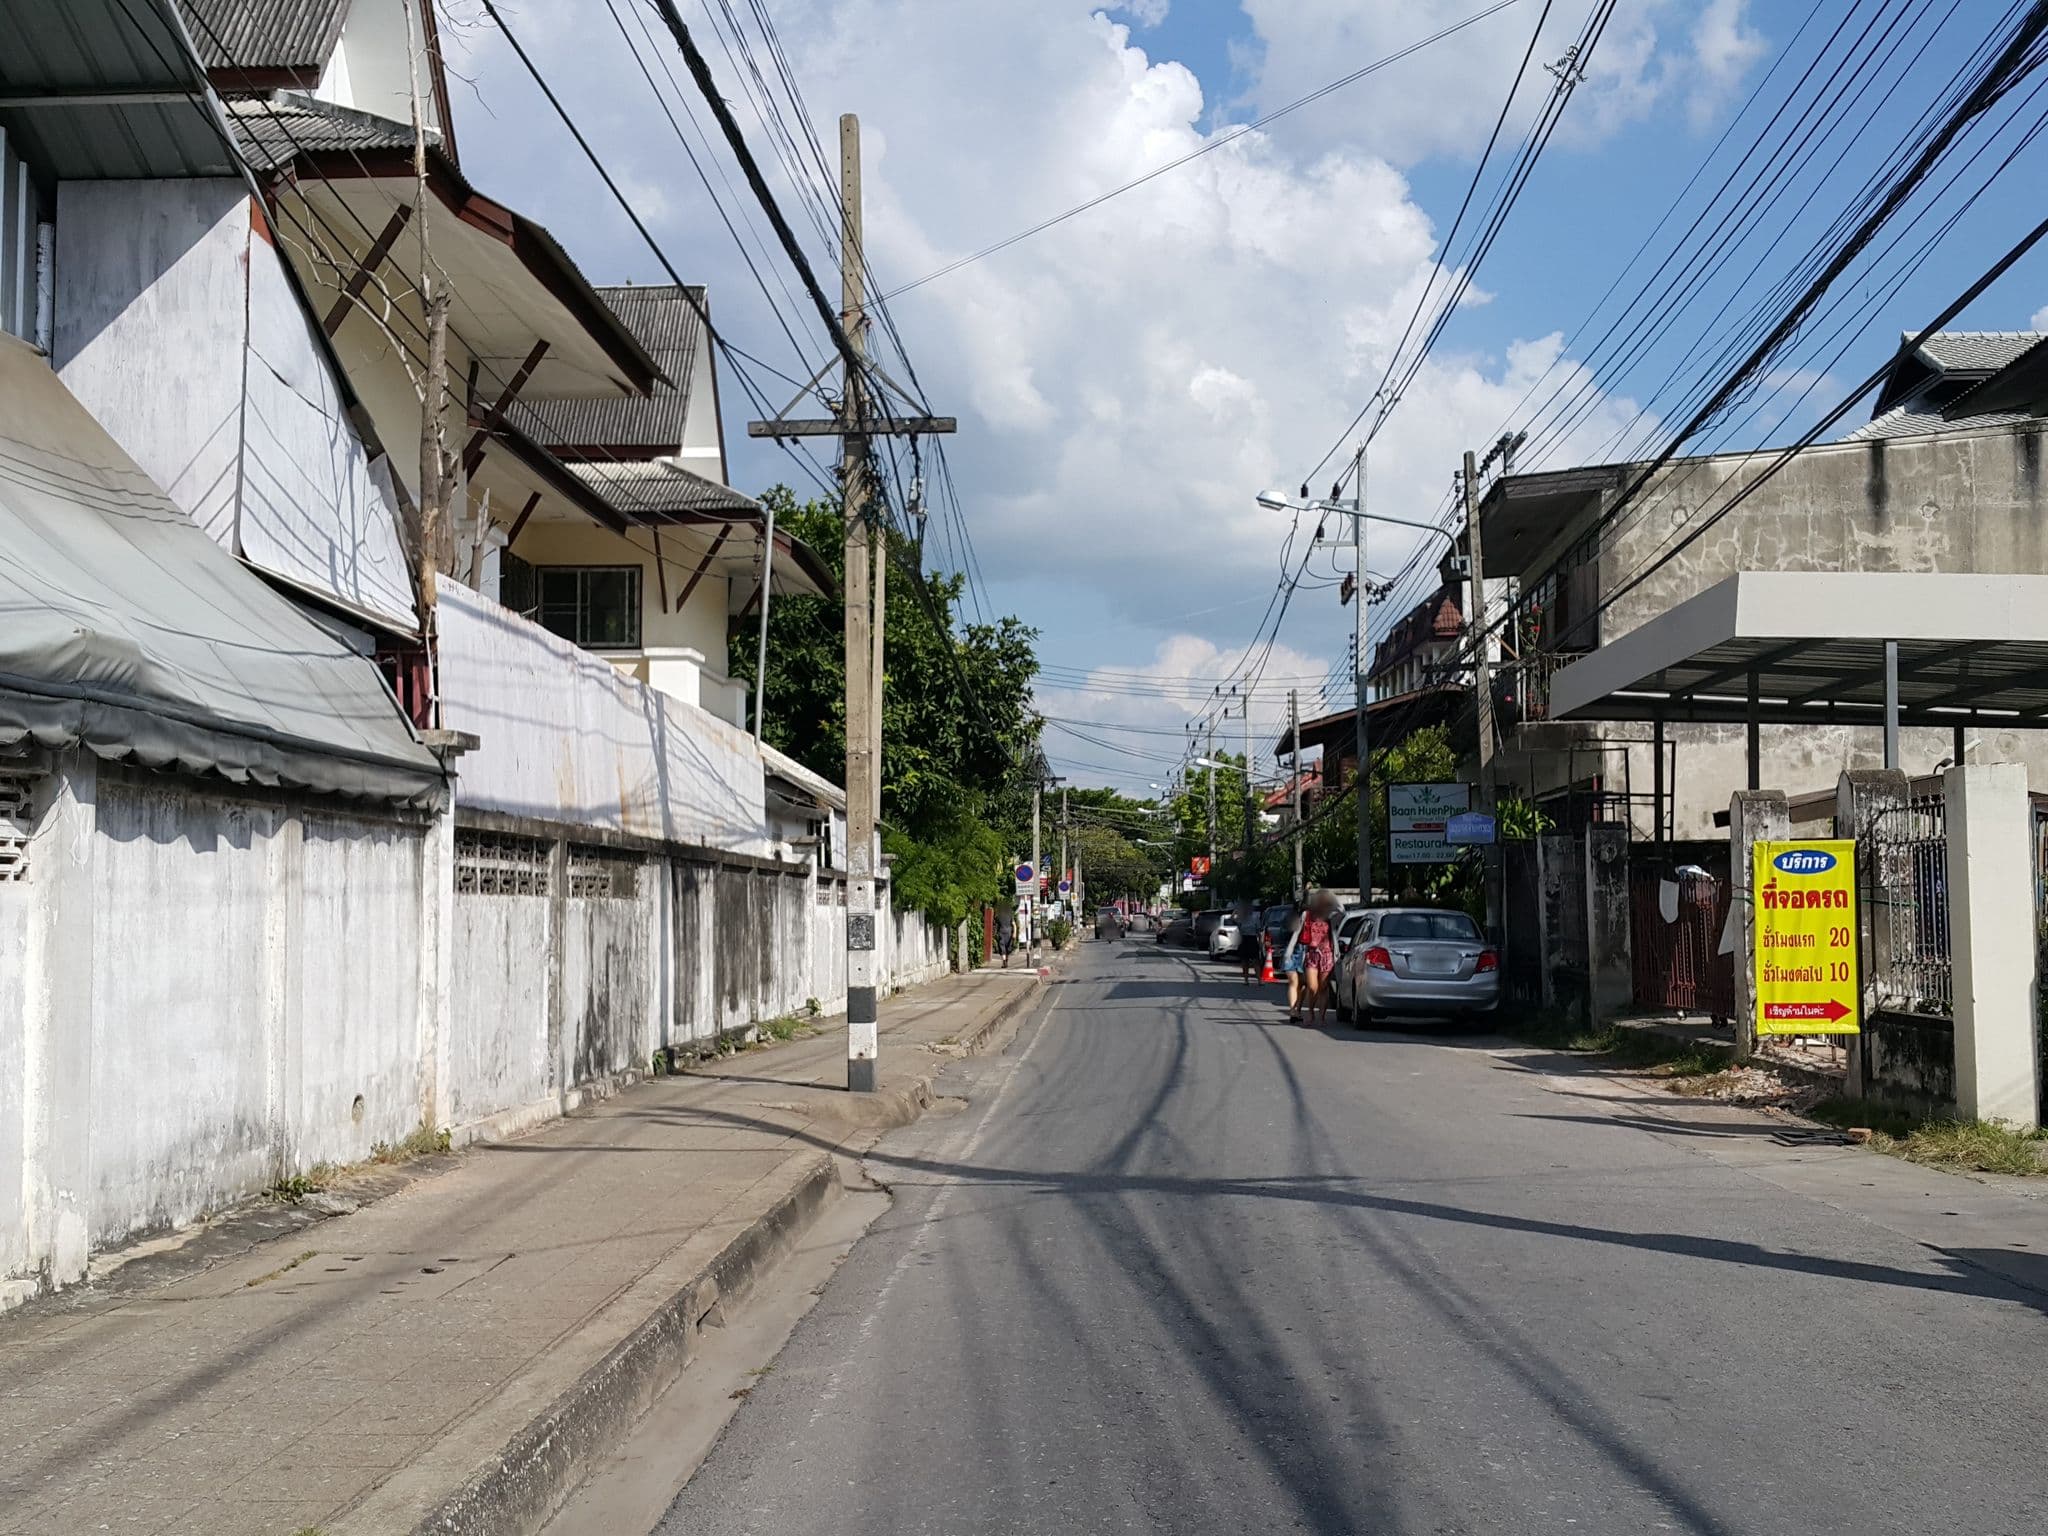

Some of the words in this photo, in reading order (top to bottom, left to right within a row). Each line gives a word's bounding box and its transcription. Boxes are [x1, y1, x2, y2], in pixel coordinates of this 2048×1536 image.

[1391, 806, 1416, 816] Baan
[1782, 853, 1828, 869] บริการ
[1762, 877, 1848, 909] ที่จอดรถ
[1763, 925, 1815, 947] ชั่วโมงแรก
[1830, 927, 1850, 947] 20
[1763, 960, 1823, 982] ชั่วโมงต่อไป
[1830, 961, 1849, 982] 10
